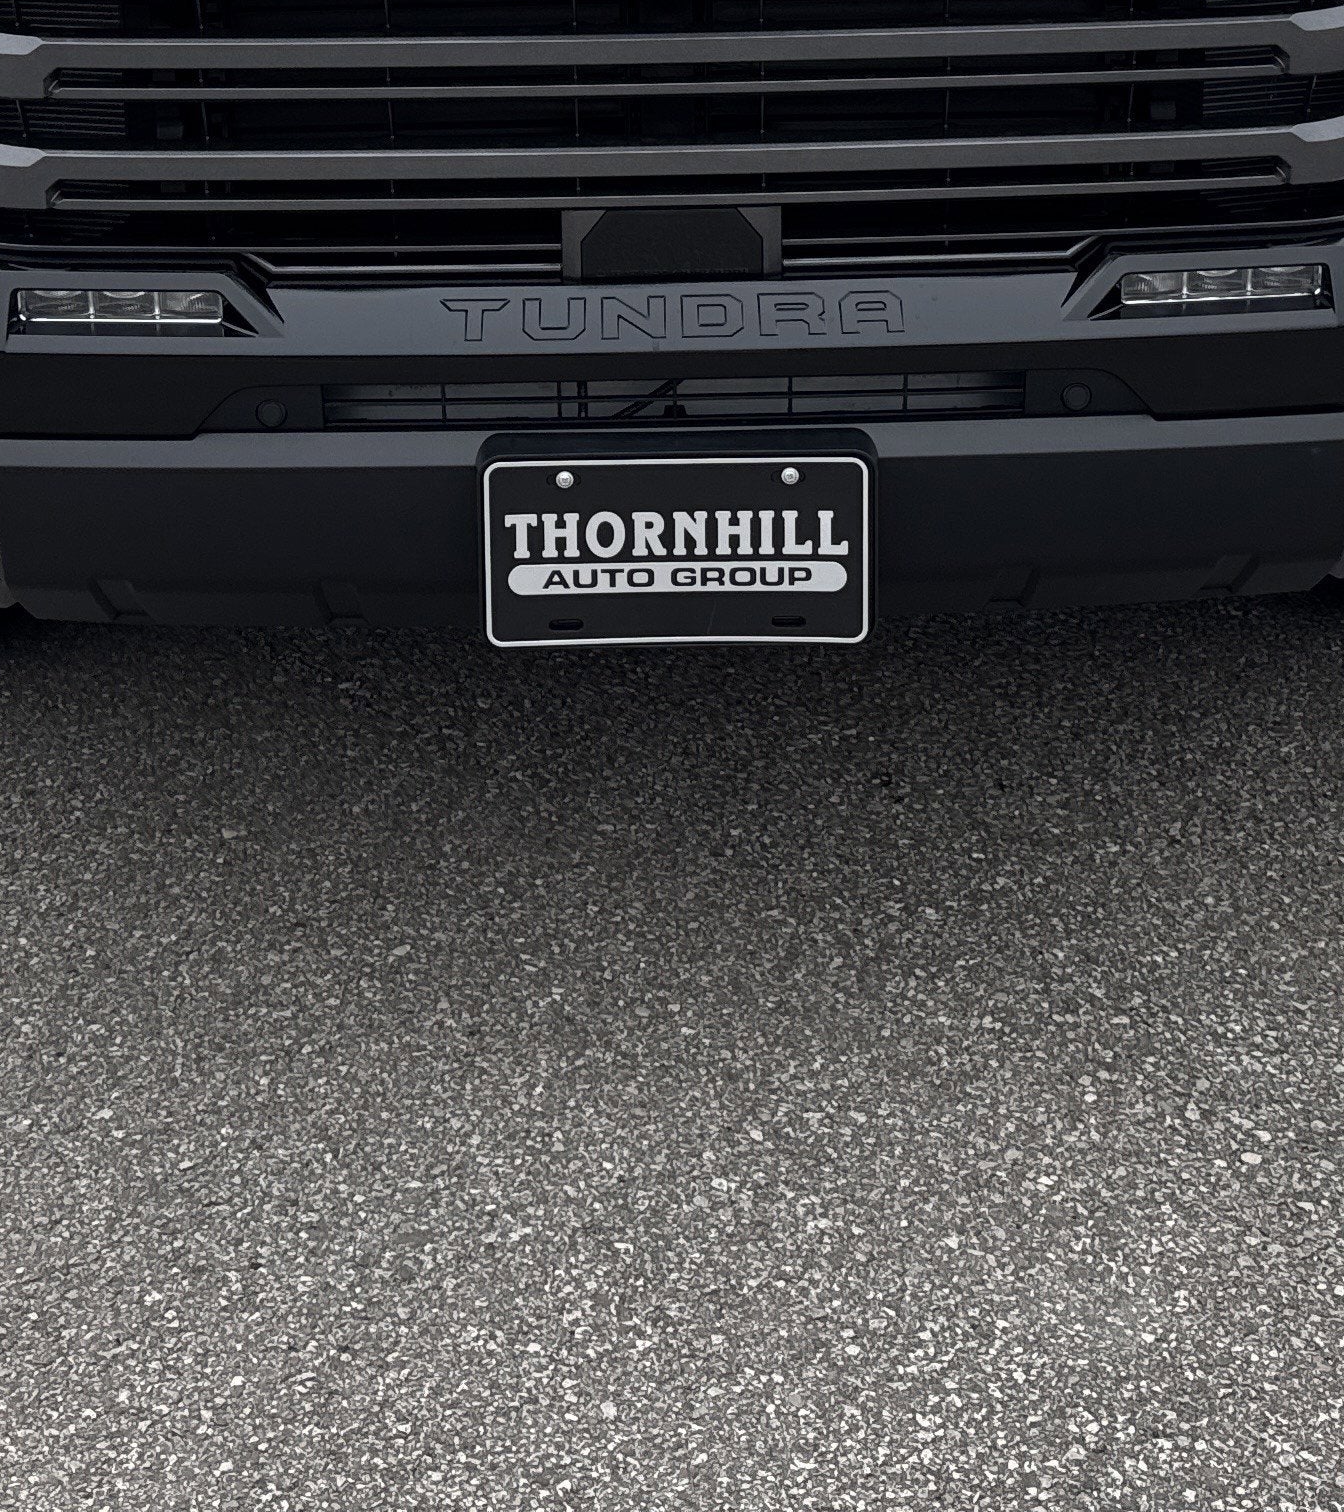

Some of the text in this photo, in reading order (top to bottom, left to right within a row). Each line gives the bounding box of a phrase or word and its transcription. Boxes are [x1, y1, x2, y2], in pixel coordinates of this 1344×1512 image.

[440, 290, 905, 342] TUNDRA
[504, 510, 849, 559] THORNHILL
[542, 566, 813, 589] AUTO GROUP
